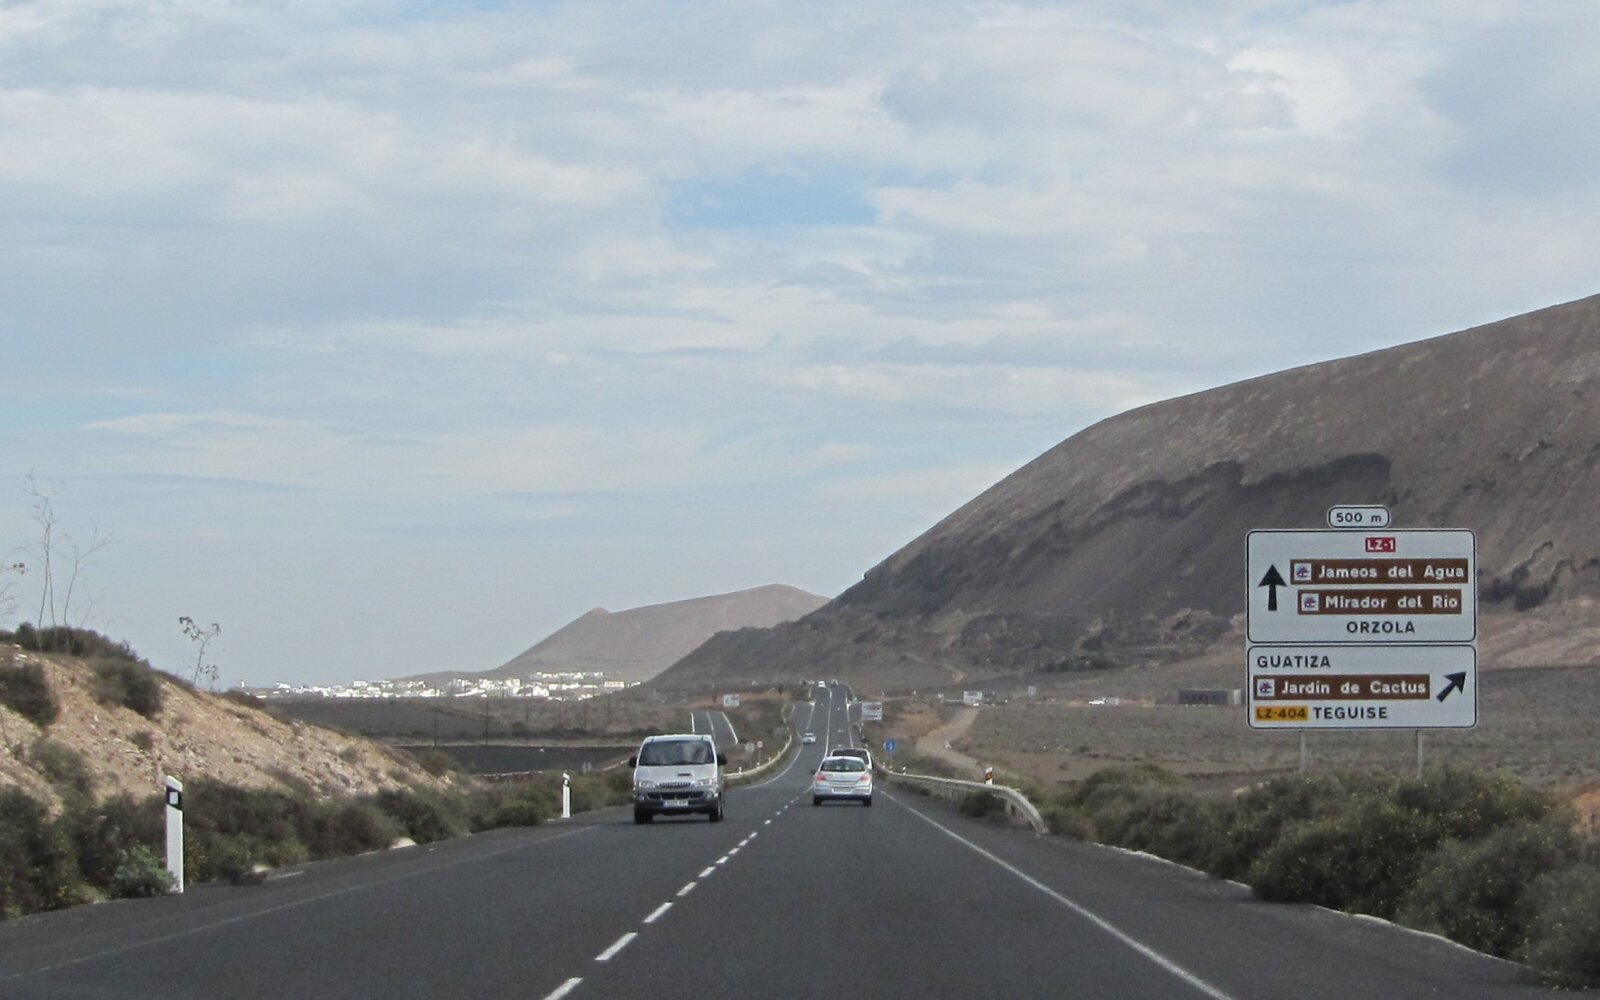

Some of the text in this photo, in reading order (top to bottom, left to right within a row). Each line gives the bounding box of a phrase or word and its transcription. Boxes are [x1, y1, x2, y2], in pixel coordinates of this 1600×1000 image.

[1336, 512, 1382, 523] 500 m
[1367, 539, 1395, 551] LZ-1
[1318, 565, 1465, 580] Jameos del Agua
[1325, 595, 1387, 608] Mirador
[1397, 595, 1422, 608] del
[1346, 621, 1415, 633] ORZOLA
[1257, 656, 1331, 668] GUATIZA
[1340, 681, 1360, 694] de
[1370, 681, 1426, 694] Cactus
[1313, 707, 1388, 719] TEGUISE
